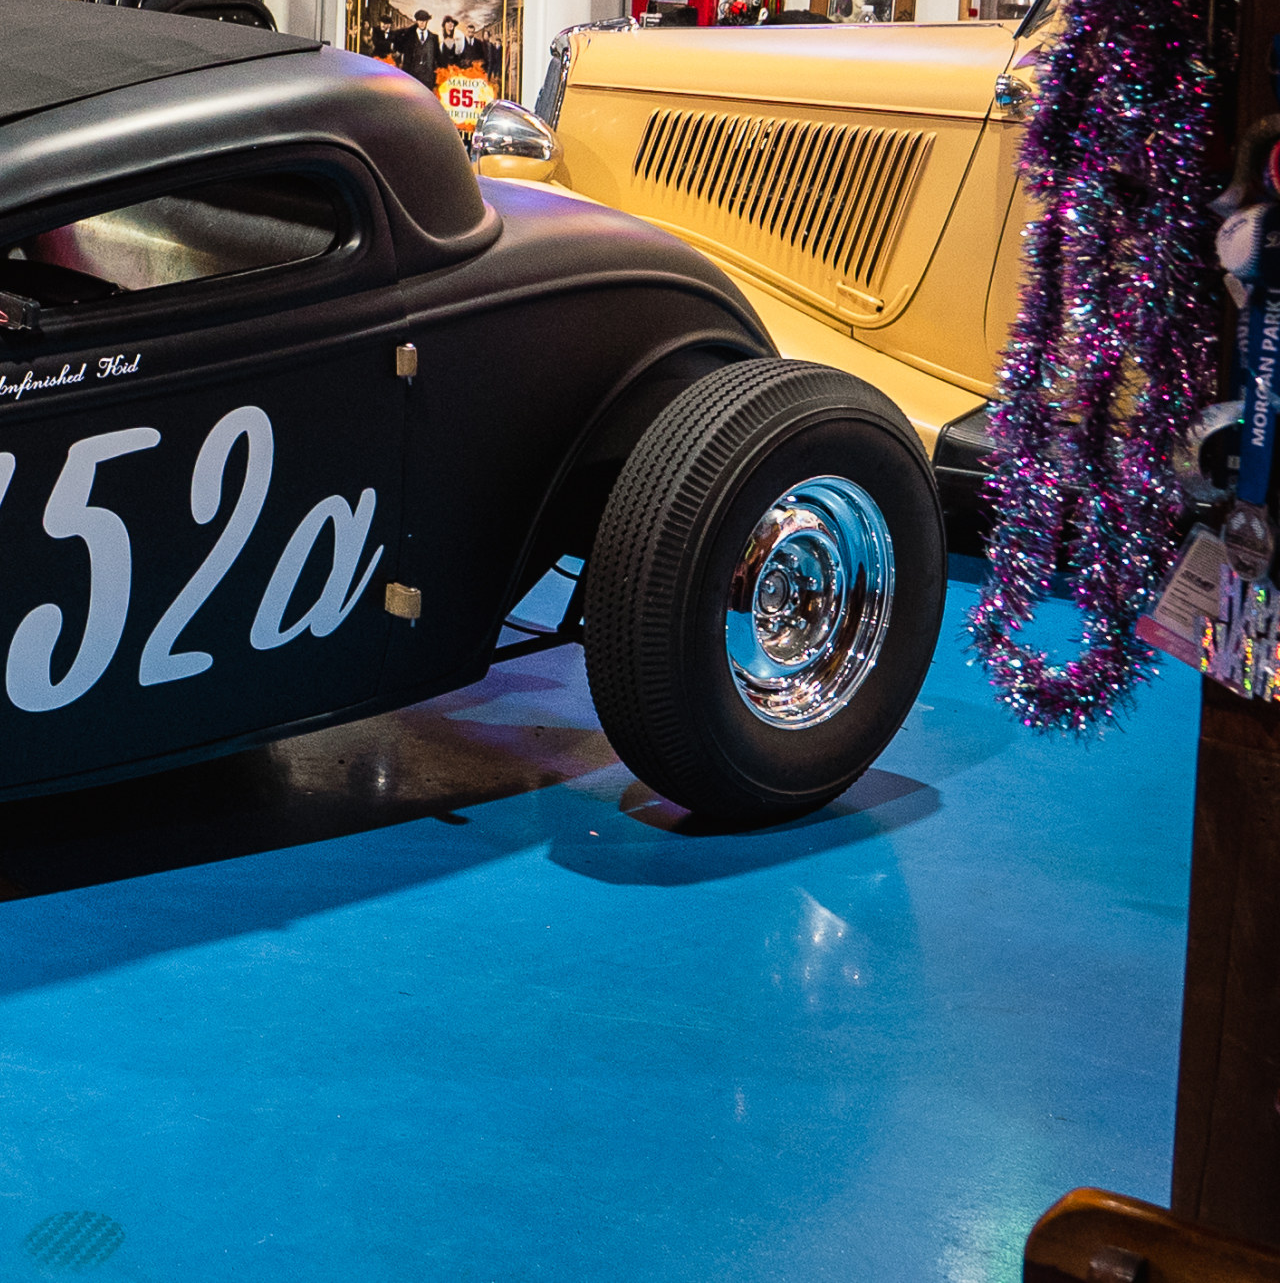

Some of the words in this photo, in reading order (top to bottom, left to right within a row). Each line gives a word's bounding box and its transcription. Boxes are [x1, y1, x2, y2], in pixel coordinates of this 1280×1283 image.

[447, 78, 487, 89] MARIO'S
[448, 87, 487, 110] 65TH
[1261, 296, 1280, 354] PARK
[96, 353, 142, 379] Kid
[1251, 355, 1278, 449] MORGAN
